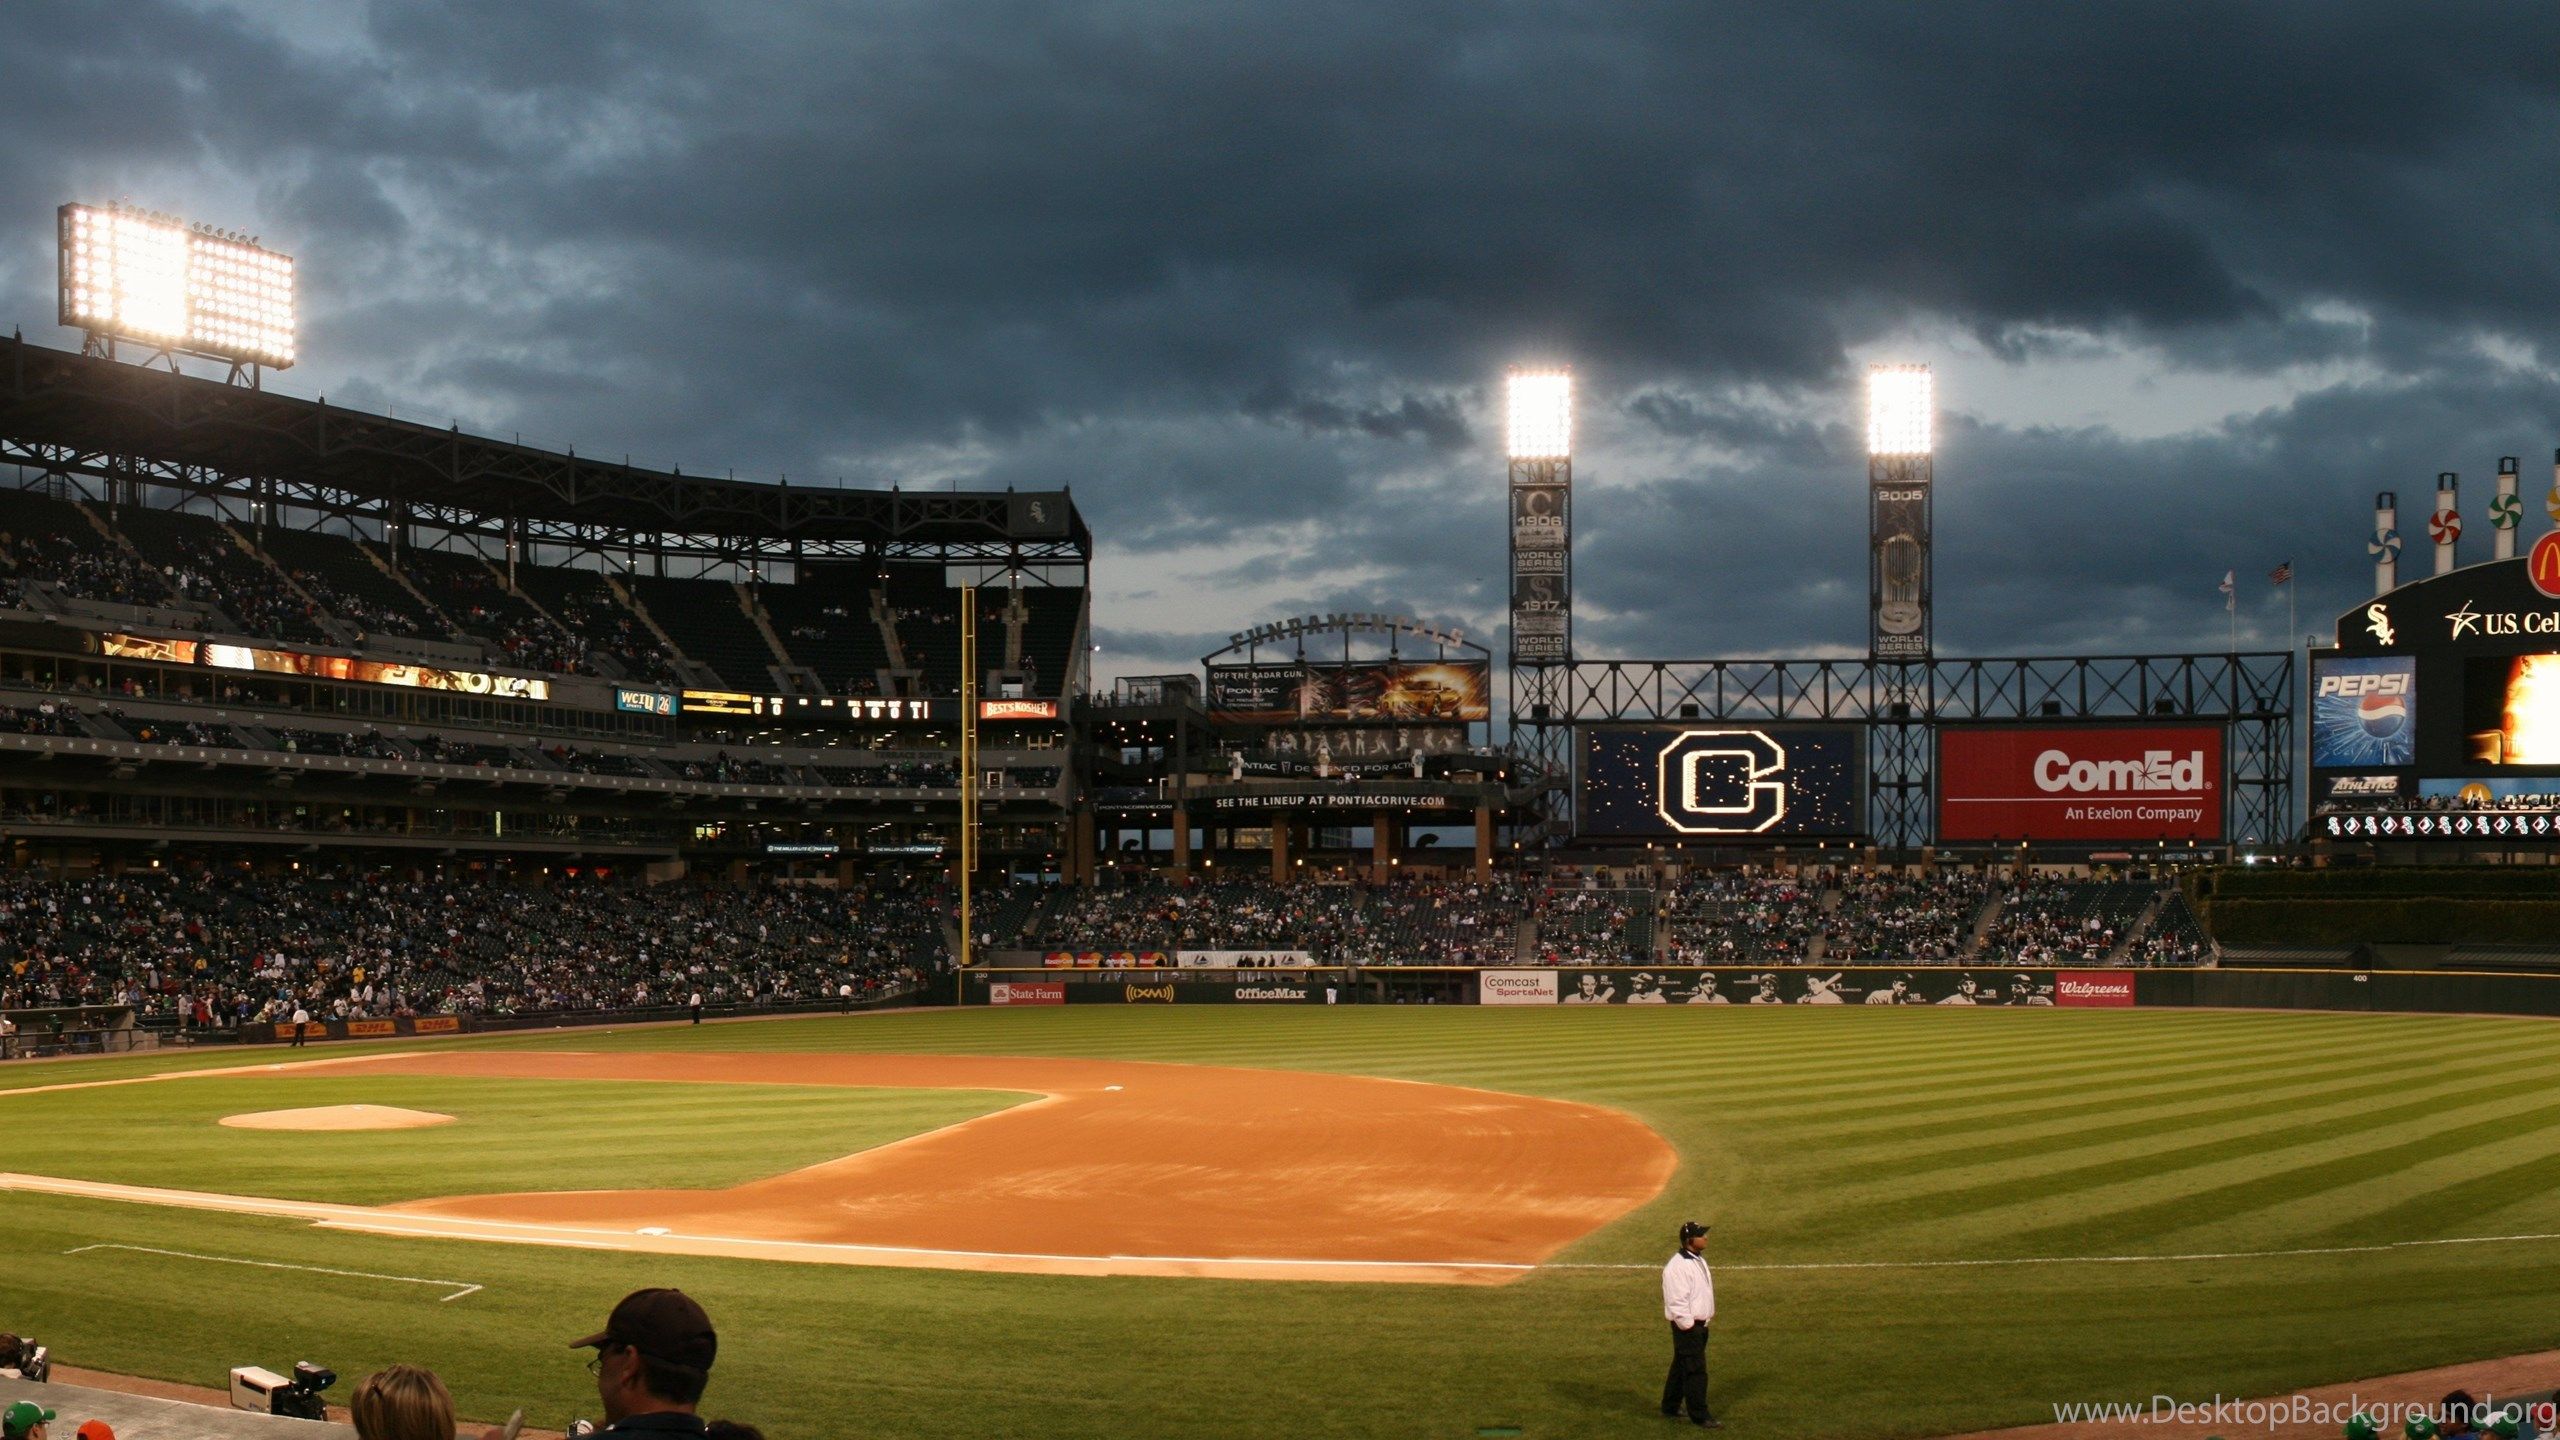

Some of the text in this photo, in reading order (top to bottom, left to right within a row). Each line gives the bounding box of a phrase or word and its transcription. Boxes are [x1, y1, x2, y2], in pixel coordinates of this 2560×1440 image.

[1878, 490, 1923, 501] 2005
[1517, 516, 1562, 526] 1906
[1517, 559, 1563, 567] SERIES
[1521, 601, 1560, 611] 1917
[2485, 613, 2520, 635] U.S.
[1229, 612, 1464, 654] FUNDAMENTALS
[1518, 636, 1563, 644] WORLD
[1231, 671, 1248, 680] THE
[1251, 671, 1281, 680] RADAR
[1283, 670, 1304, 678] GUN.
[2318, 673, 2410, 698] PEPSI
[660, 696, 669, 712] 26
[987, 701, 1049, 718] BEST'S KOSHER
[852, 706, 860, 718] 0
[871, 707, 880, 718] 0
[890, 707, 899, 719] 0
[1294, 764, 1360, 772] DESGNED
[1364, 764, 1389, 772] FOR
[1391, 762, 1417, 770] ACTIO
[2033, 749, 2204, 792] ComEd
[1658, 729, 1785, 833] C
[1216, 796, 1445, 808] SEE THE LINEUP AT PONTIACDRIVE.COM
[2065, 806, 2203, 823] An Exelon Company
[1486, 977, 1539, 988] comcast
[1010, 988, 1063, 999] State Farm
[1235, 987, 1307, 1000] OfficeMax
[1496, 988, 1554, 997] SportsNet
[2060, 981, 2130, 998] Walgreens
[355, 1022, 388, 1033] DHL
[422, 1018, 452, 1030] DHL
